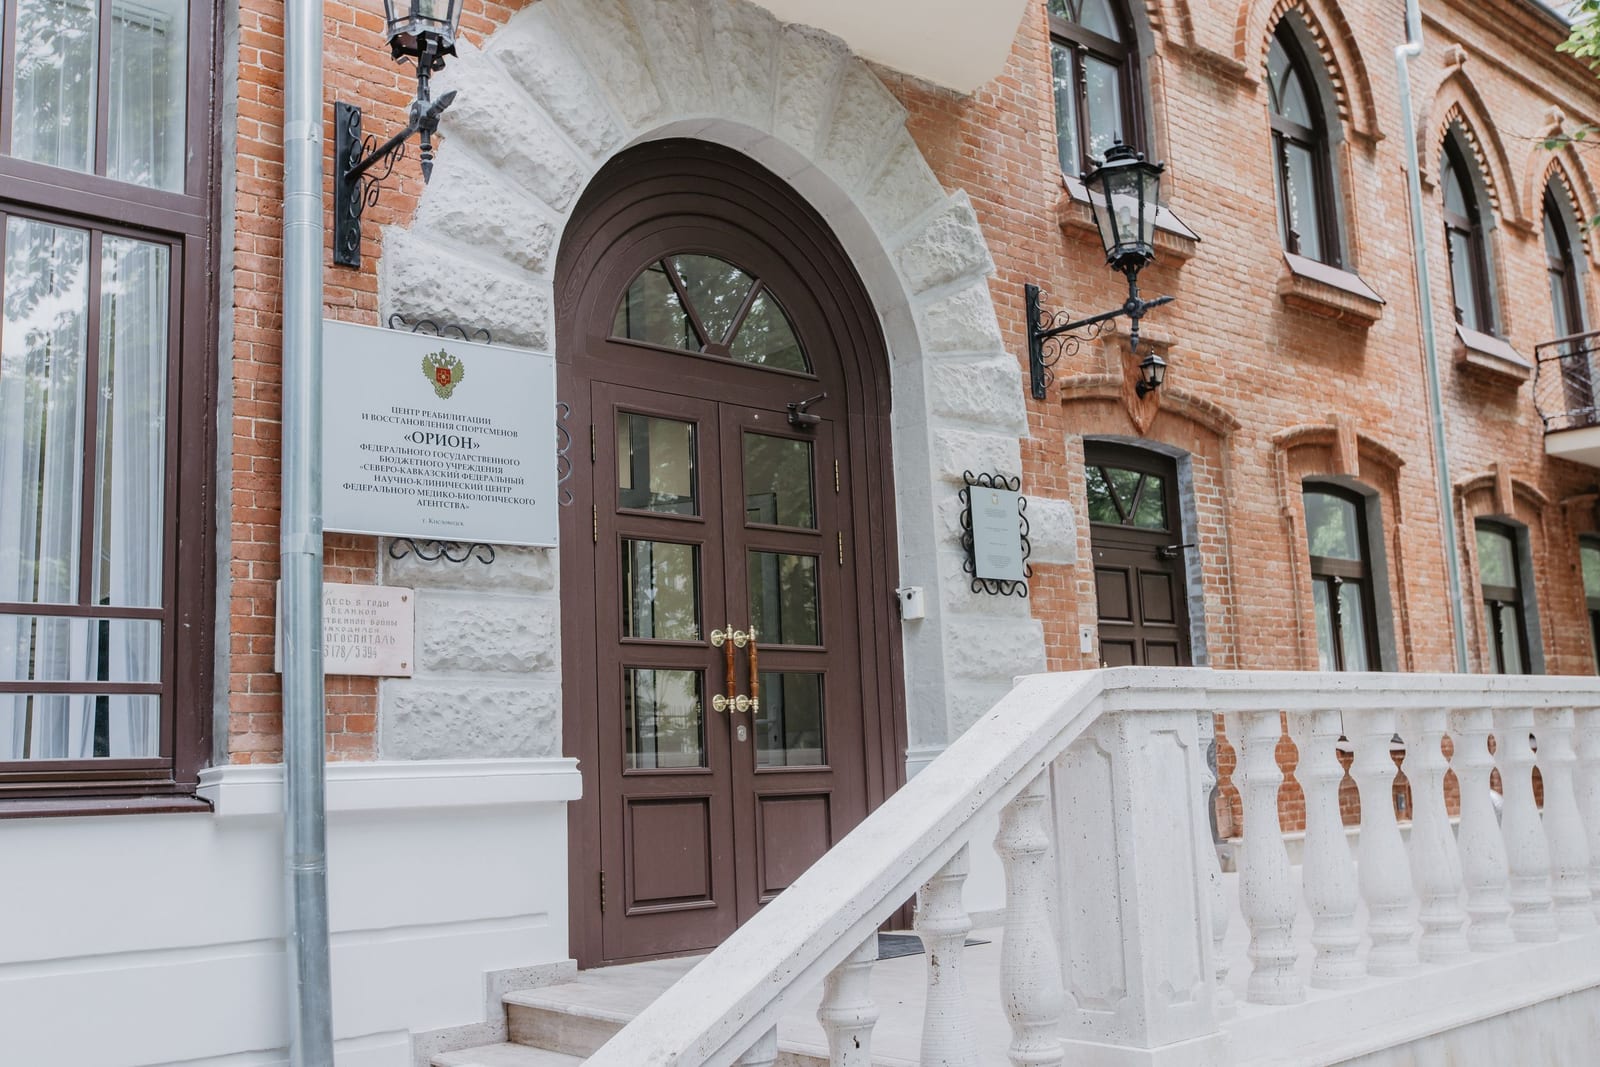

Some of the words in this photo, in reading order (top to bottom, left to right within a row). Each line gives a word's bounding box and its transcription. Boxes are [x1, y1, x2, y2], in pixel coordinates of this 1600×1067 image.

[361, 412, 369, 420] И
[370, 414, 454, 431] ВОССТАНОВЛЕНИЯ
[455, 424, 518, 438] СПОРТСМЕНОВ
[391, 406, 421, 416] ЦЕНТР
[421, 409, 491, 425] РЕАБИЛИТАЦИИ
[403, 431, 480, 449] «ОРИОН»
[359, 443, 431, 457] ФЕДЕРАЛЬНОГО
[432, 450, 521, 466] ГОСУДАРСТВЕННОГО
[359, 463, 460, 479] «СЕВЕРО-КАВКАЗСКИЙ
[461, 472, 524, 485] ФЕДЕРАЛЬНЫЙ
[379, 455, 444, 469] БЮДЖЕТНОГО
[445, 462, 503, 475] УЧРЕЖДЕНИЯ
[342, 482, 416, 496] ФЕДЕРАЛЬНОГО
[416, 489, 536, 506] МЕДИКО-БИОЛОГИЧЕСКОГО
[374, 474, 484, 491] НАУЧНО-КЛИНИЧЕСКИЙ
[485, 485, 512, 494] ЦЕНТР
[416, 499, 470, 510] АГЕНТСТВА»
[325, 598, 352, 606] ДЕСЬ
